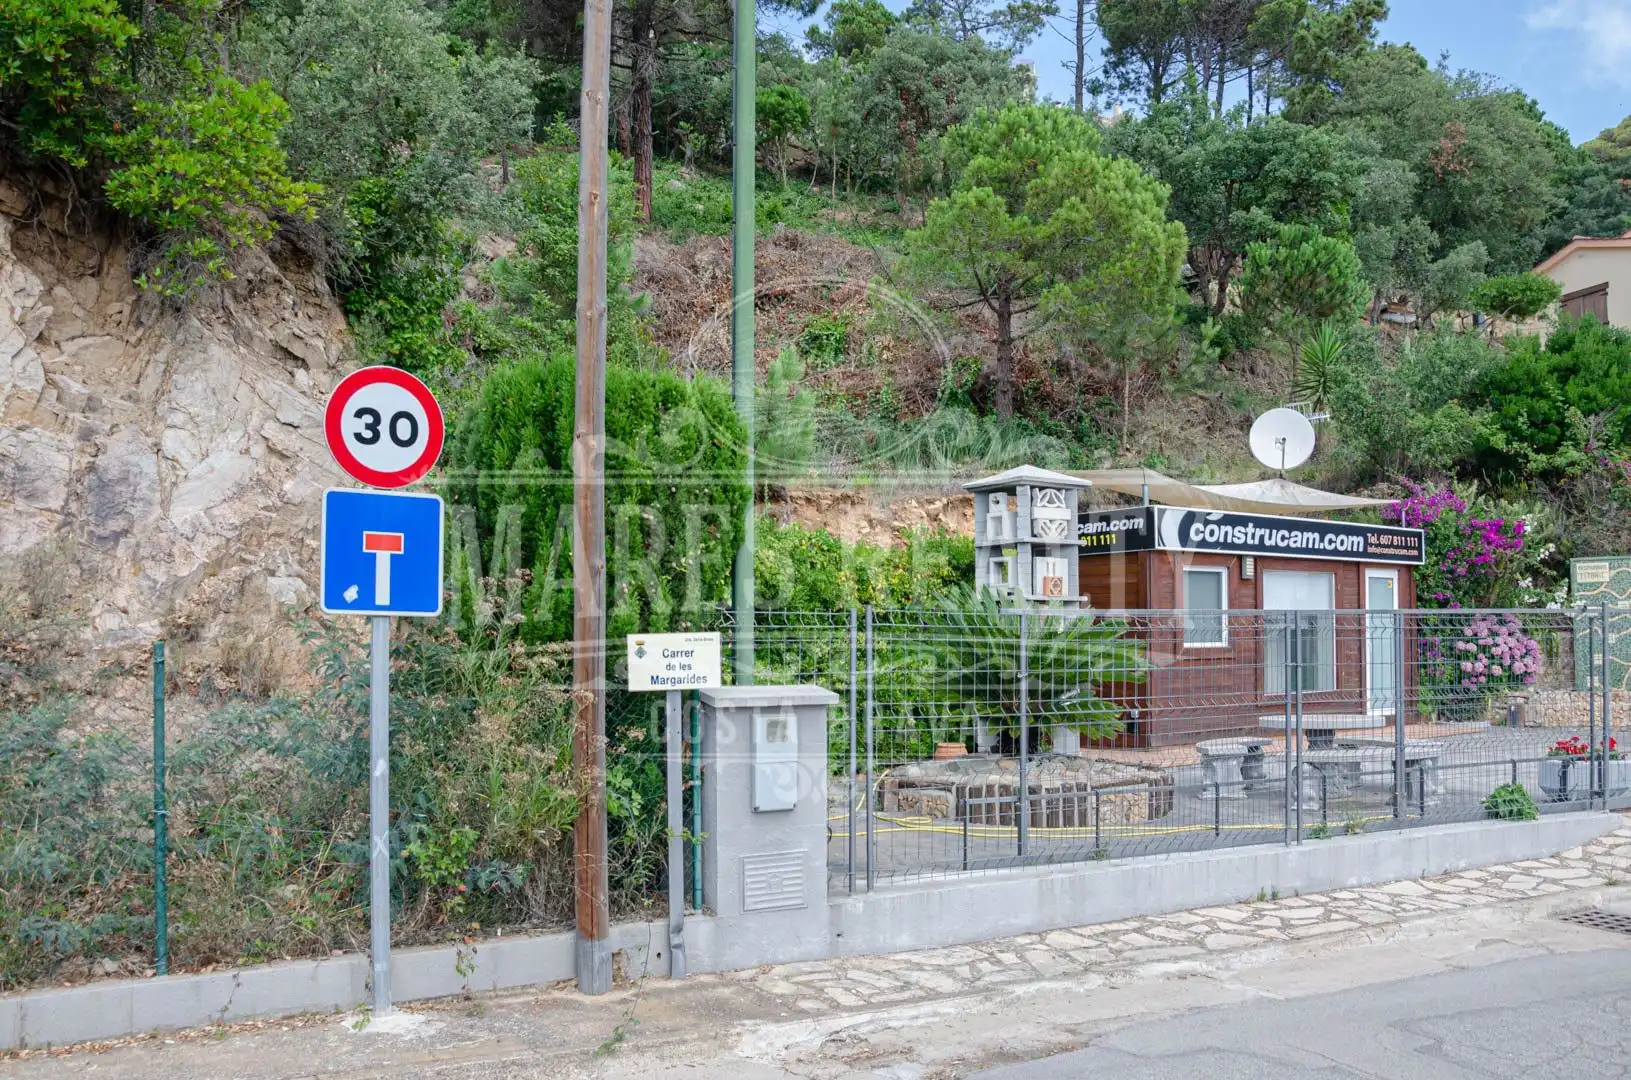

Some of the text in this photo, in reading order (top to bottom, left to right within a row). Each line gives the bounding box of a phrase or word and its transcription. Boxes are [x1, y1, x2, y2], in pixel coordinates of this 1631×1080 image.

[353, 407, 419, 448] 30
[1100, 533, 1116, 546] 111
[1189, 521, 1364, 552] construcam.com
[1367, 533, 1418, 548] Tel. 607 811 111
[662, 648, 694, 659] Carrer
[665, 662, 692, 671] de les
[650, 674, 708, 686] Margarides
